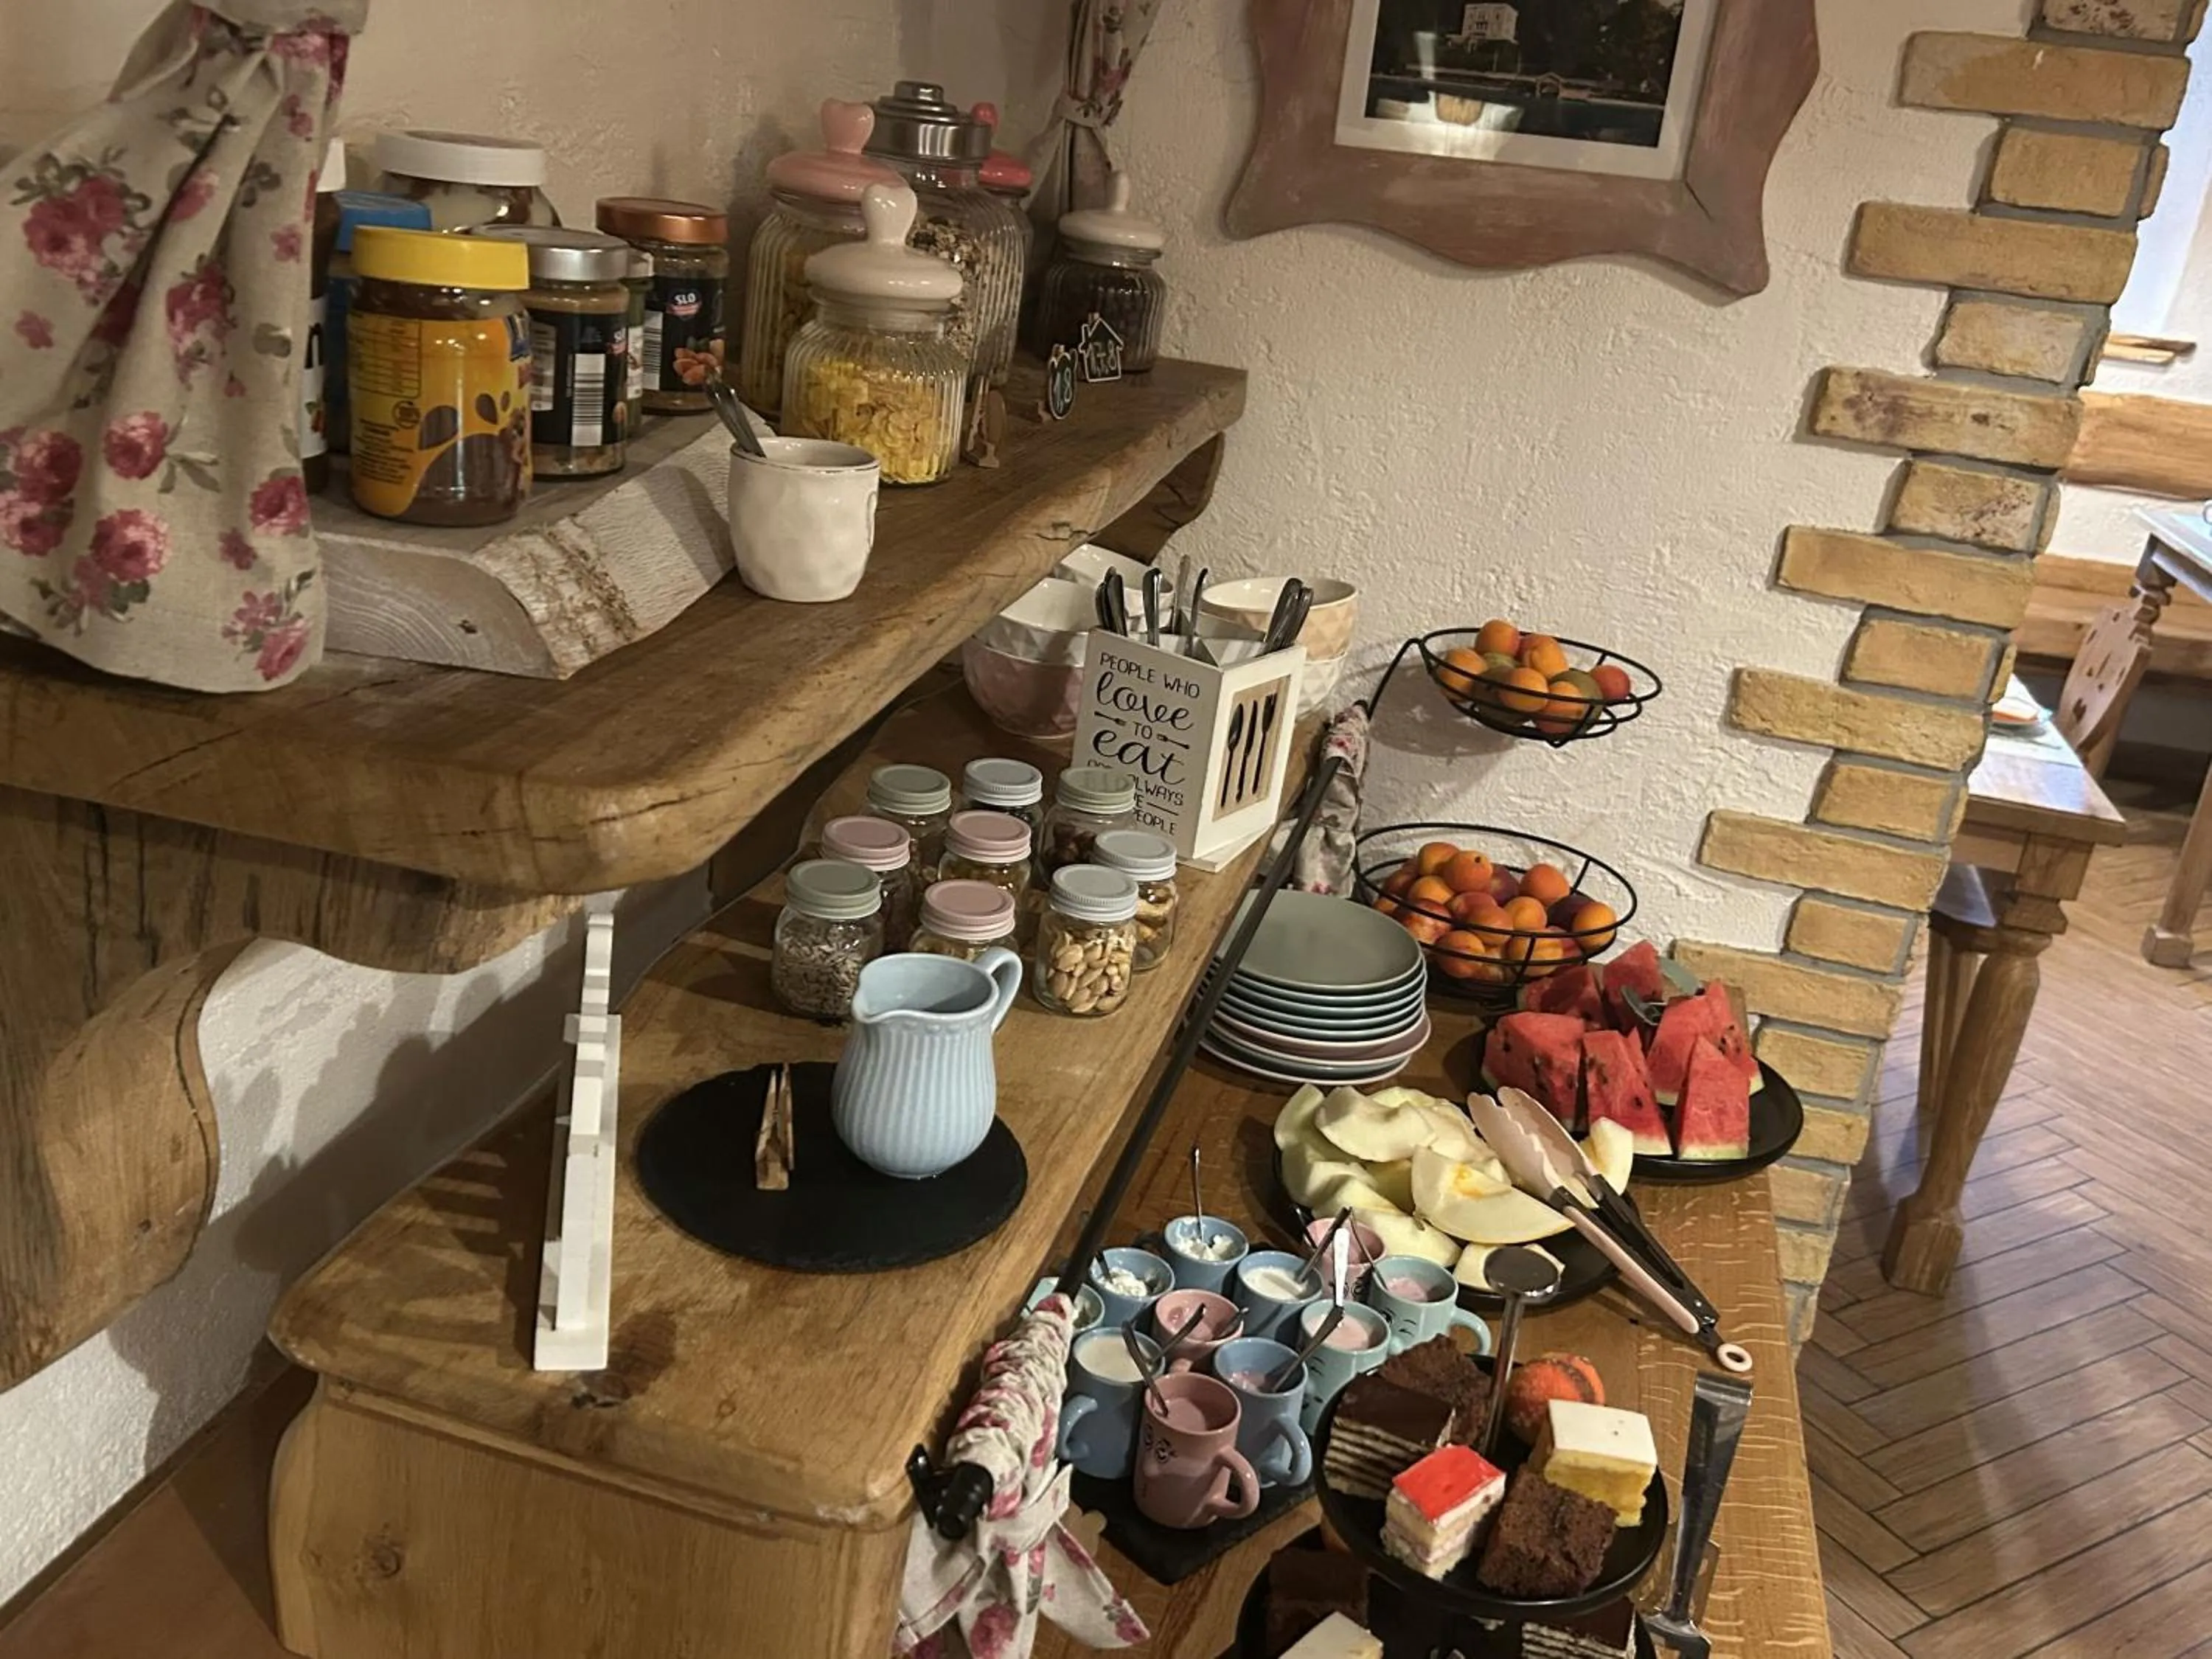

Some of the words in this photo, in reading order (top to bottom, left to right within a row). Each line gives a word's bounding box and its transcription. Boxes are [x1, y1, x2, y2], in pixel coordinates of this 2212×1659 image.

[1100, 652, 1155, 683] PEOPLE
[1164, 673, 1200, 698] WHO
[1096, 671, 1194, 731] love
[1133, 720, 1152, 740] TO
[1093, 729, 1185, 785] eat
